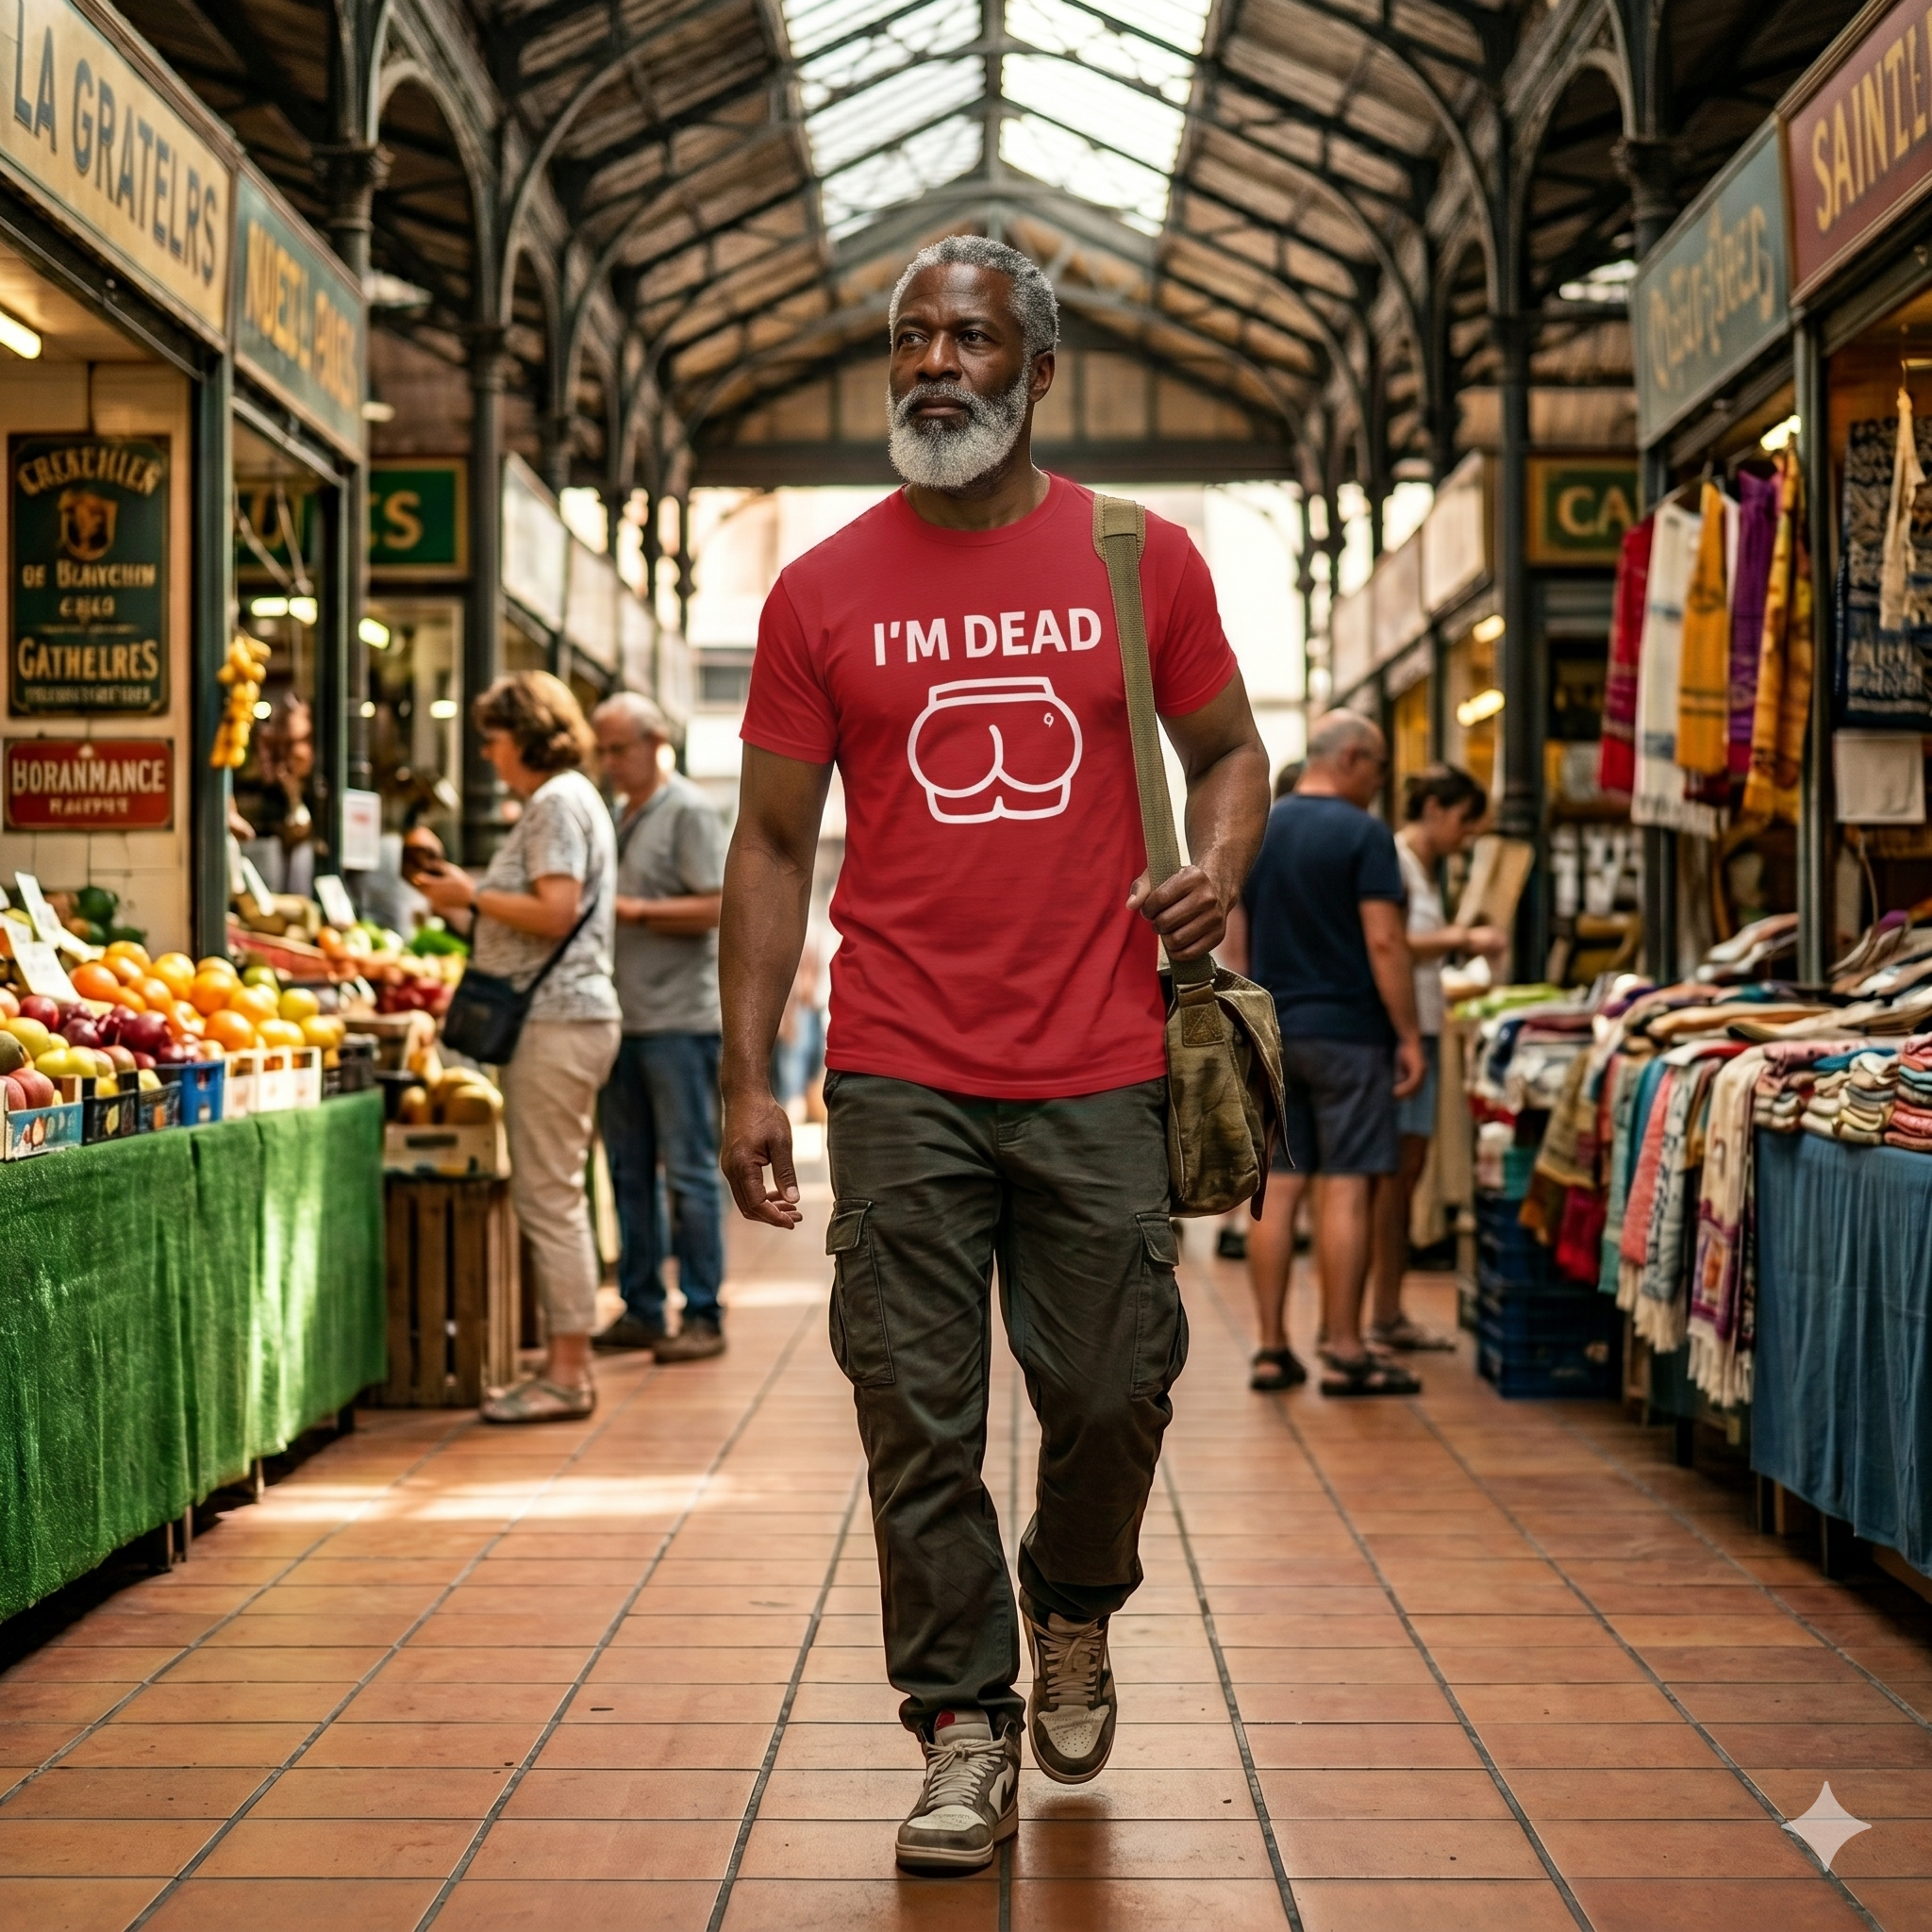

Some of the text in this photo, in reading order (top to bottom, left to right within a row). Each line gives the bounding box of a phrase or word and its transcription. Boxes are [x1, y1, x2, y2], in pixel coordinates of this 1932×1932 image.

[13, 0, 218, 289] LA GRATELRS
[874, 608, 1102, 666] I'M DEAD
